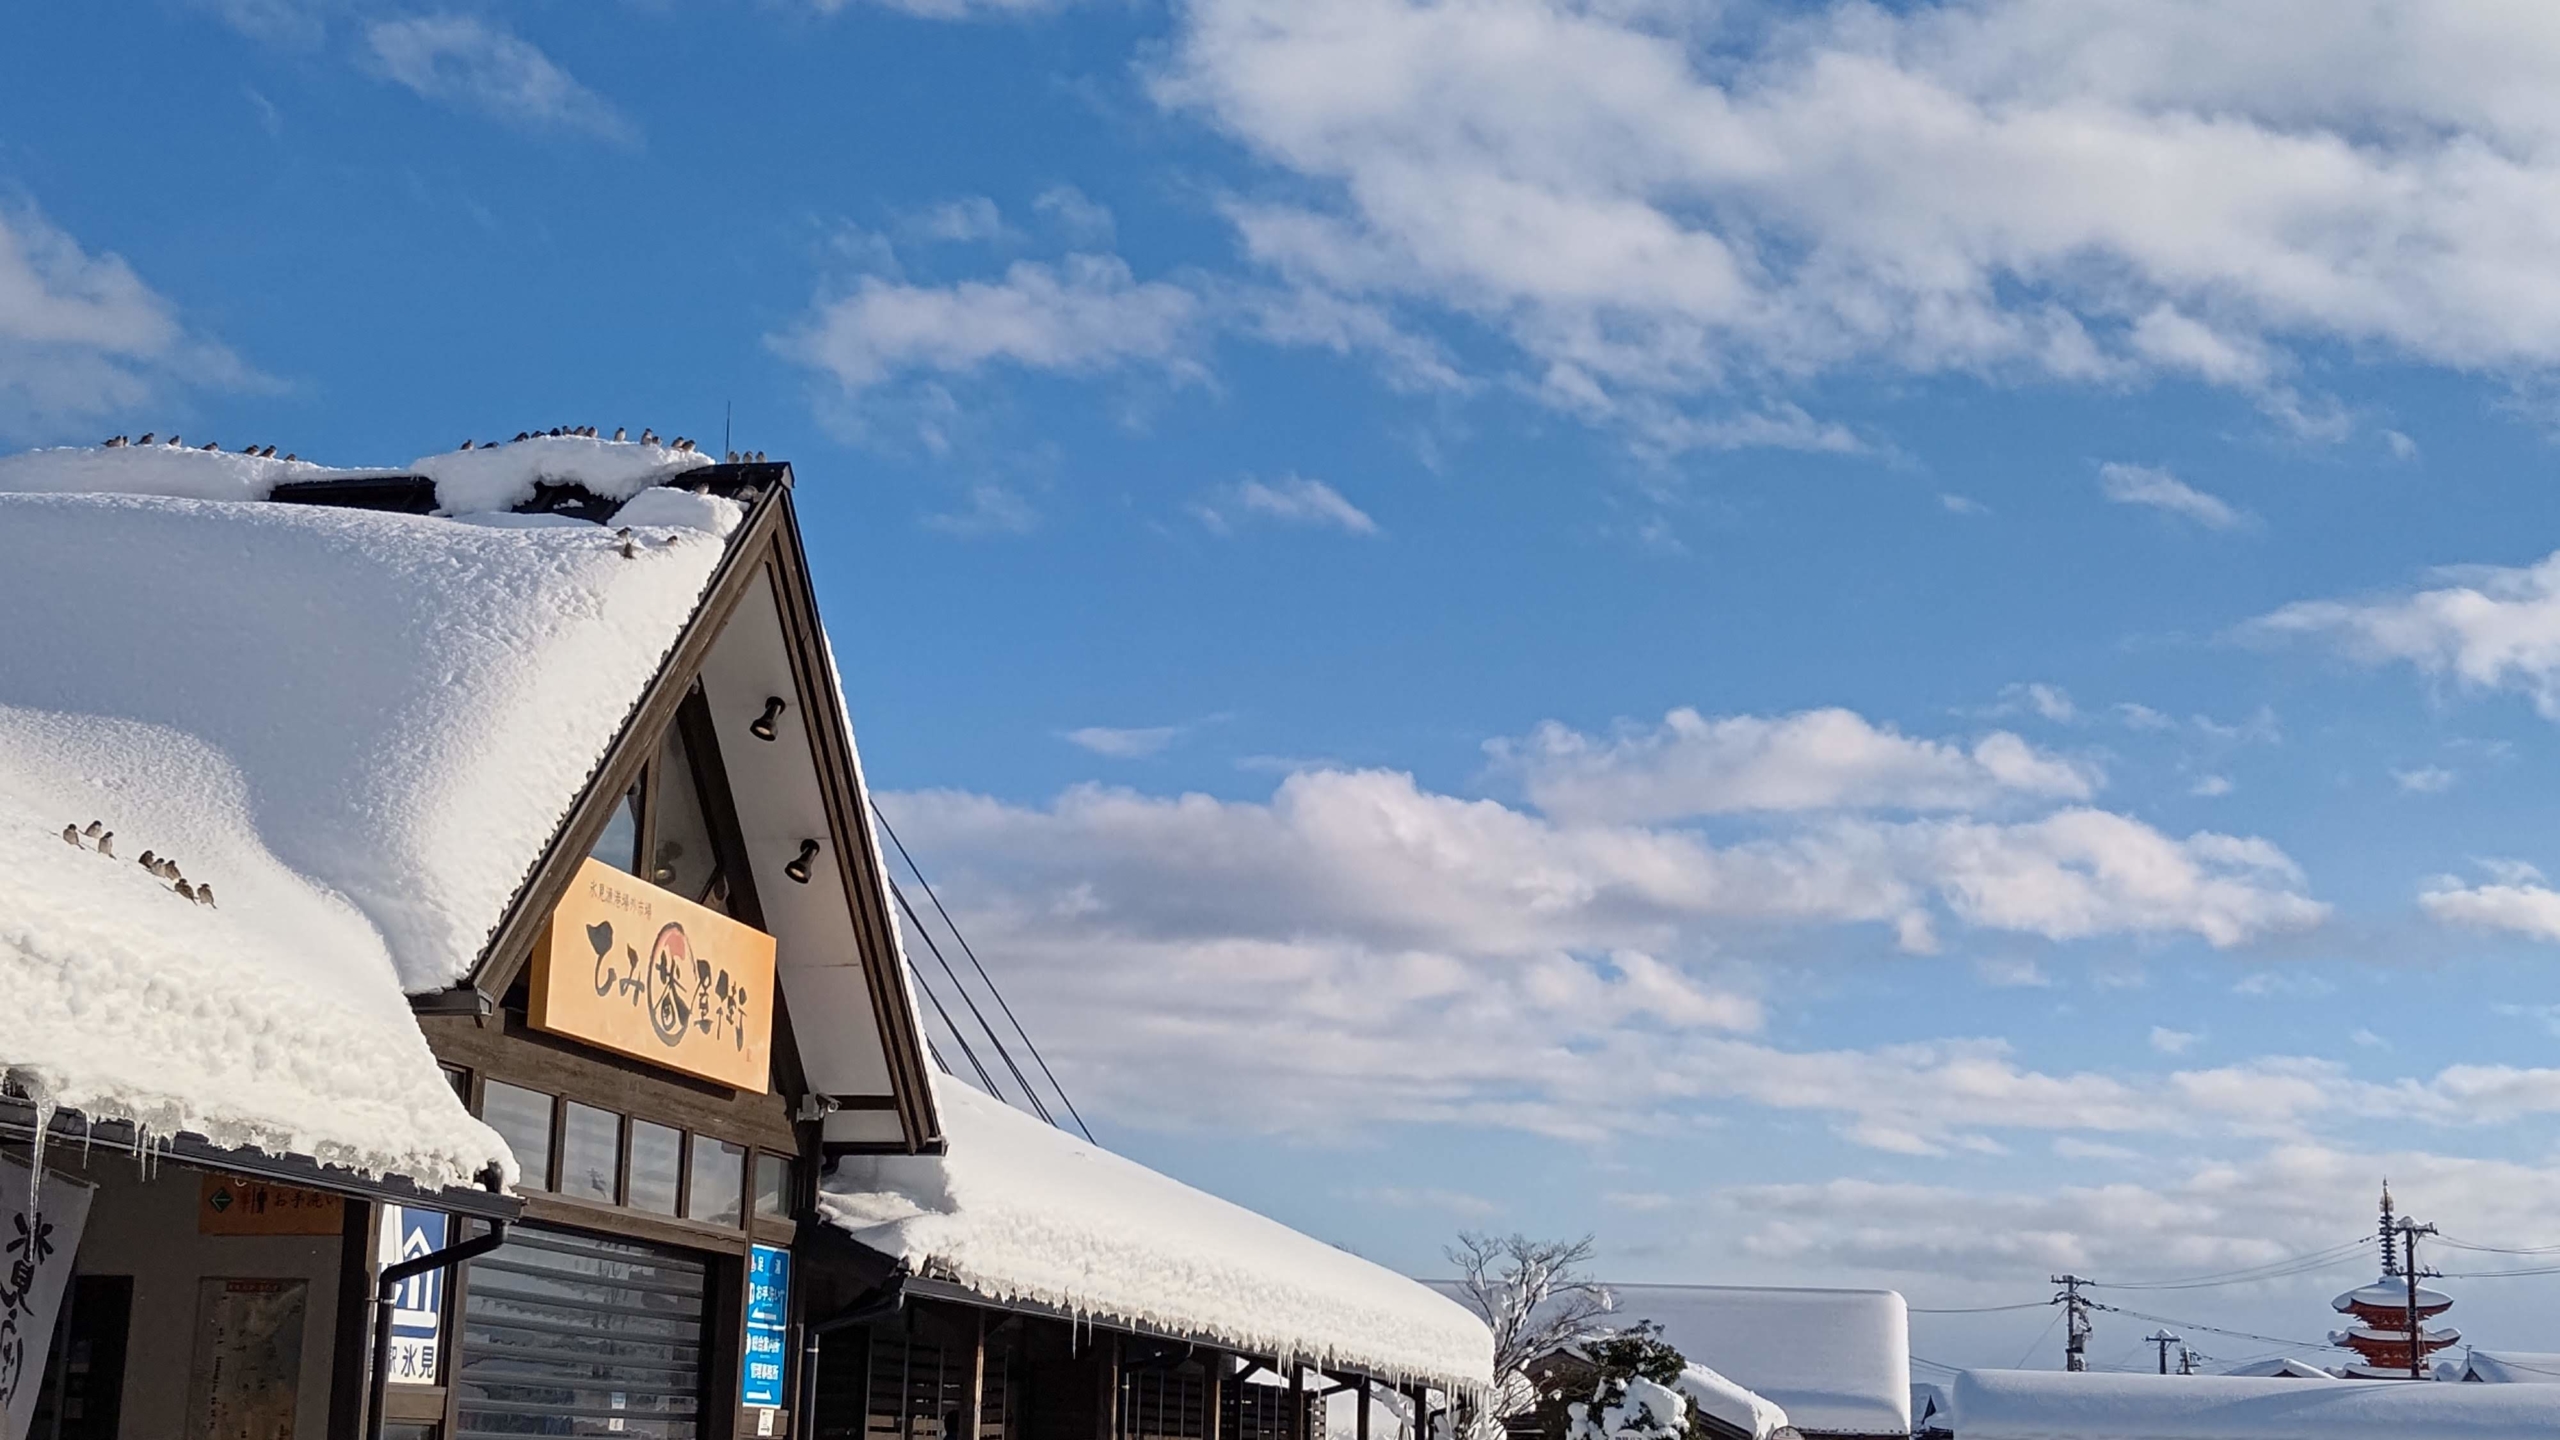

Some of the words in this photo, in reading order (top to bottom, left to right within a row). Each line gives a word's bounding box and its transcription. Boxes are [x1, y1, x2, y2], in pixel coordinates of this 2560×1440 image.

[586, 921, 748, 1052] ひみ番屋街
